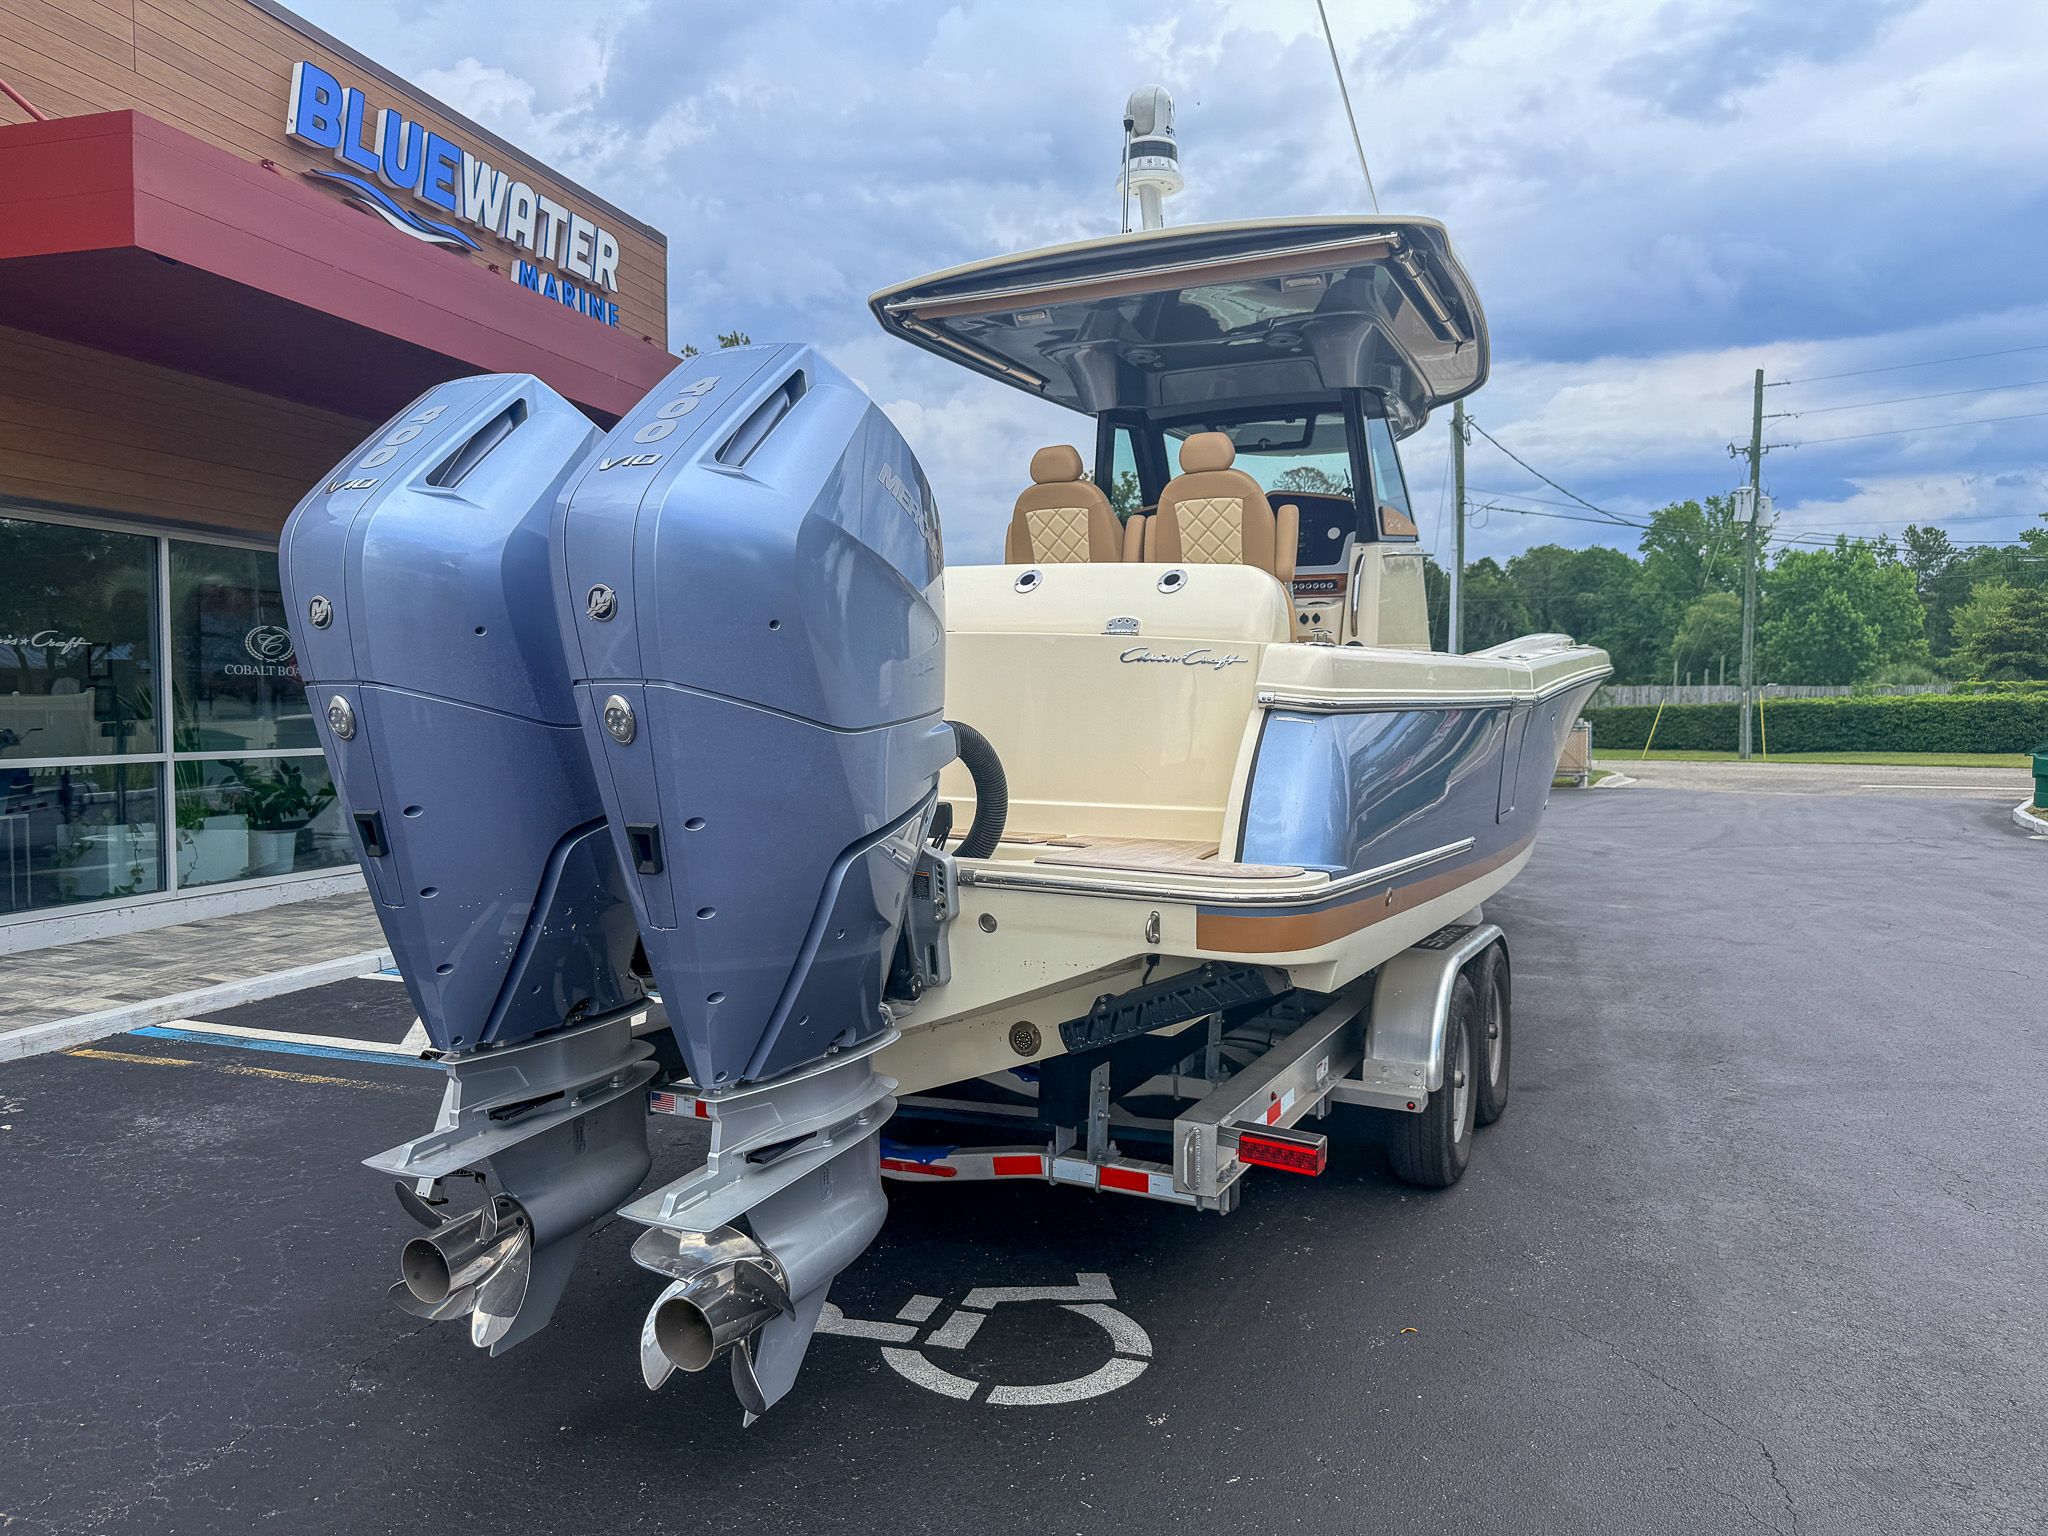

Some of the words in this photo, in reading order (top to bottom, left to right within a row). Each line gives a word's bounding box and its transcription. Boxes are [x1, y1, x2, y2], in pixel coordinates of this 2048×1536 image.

[511, 260, 620, 329] MARINE
[633, 376, 722, 444] 400
[360, 405, 449, 469] 400
[599, 453, 663, 472] V10
[326, 477, 379, 494] V10
[31, 629, 92, 655] Craft
[224, 663, 275, 676] COBALT
